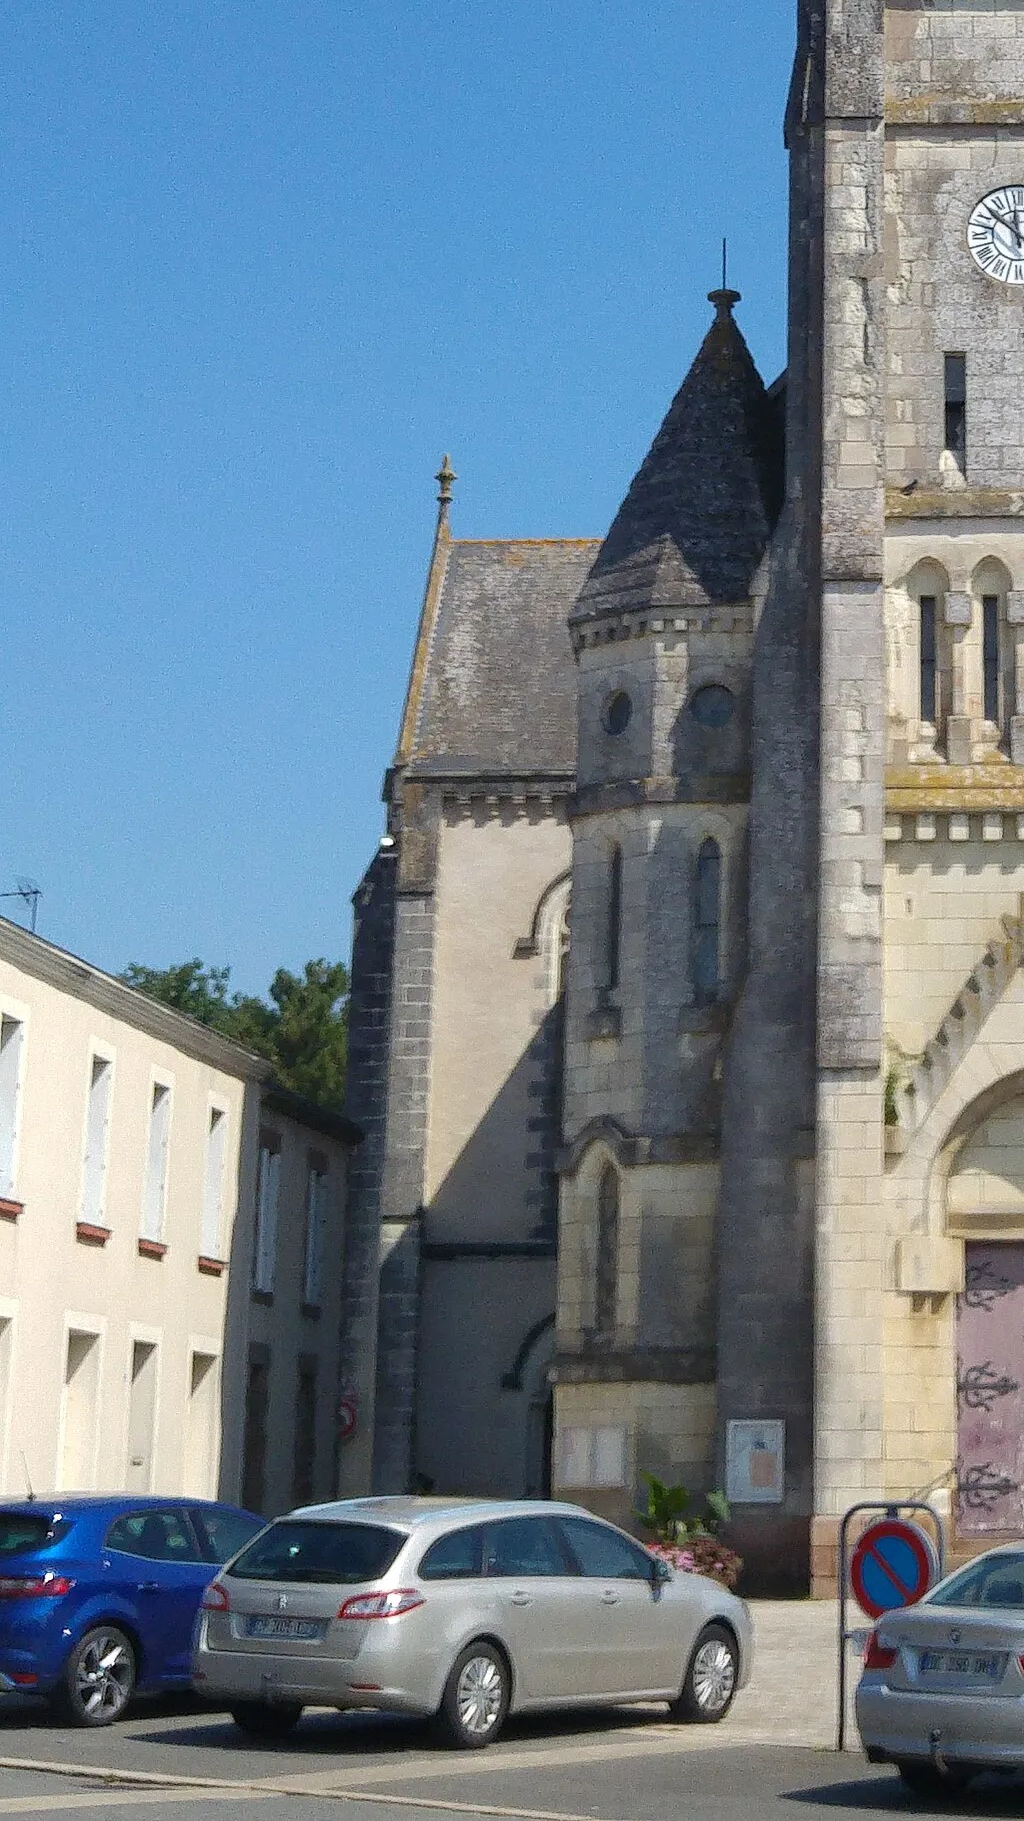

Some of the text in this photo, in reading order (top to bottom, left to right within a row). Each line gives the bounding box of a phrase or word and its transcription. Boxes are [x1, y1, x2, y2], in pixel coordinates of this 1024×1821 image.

[1011, 190, 1024, 206] XII
[973, 231, 987, 240] IX
[976, 246, 994, 264] VIII
[991, 259, 1007, 277] VII
[1014, 264, 1024, 280] VI
